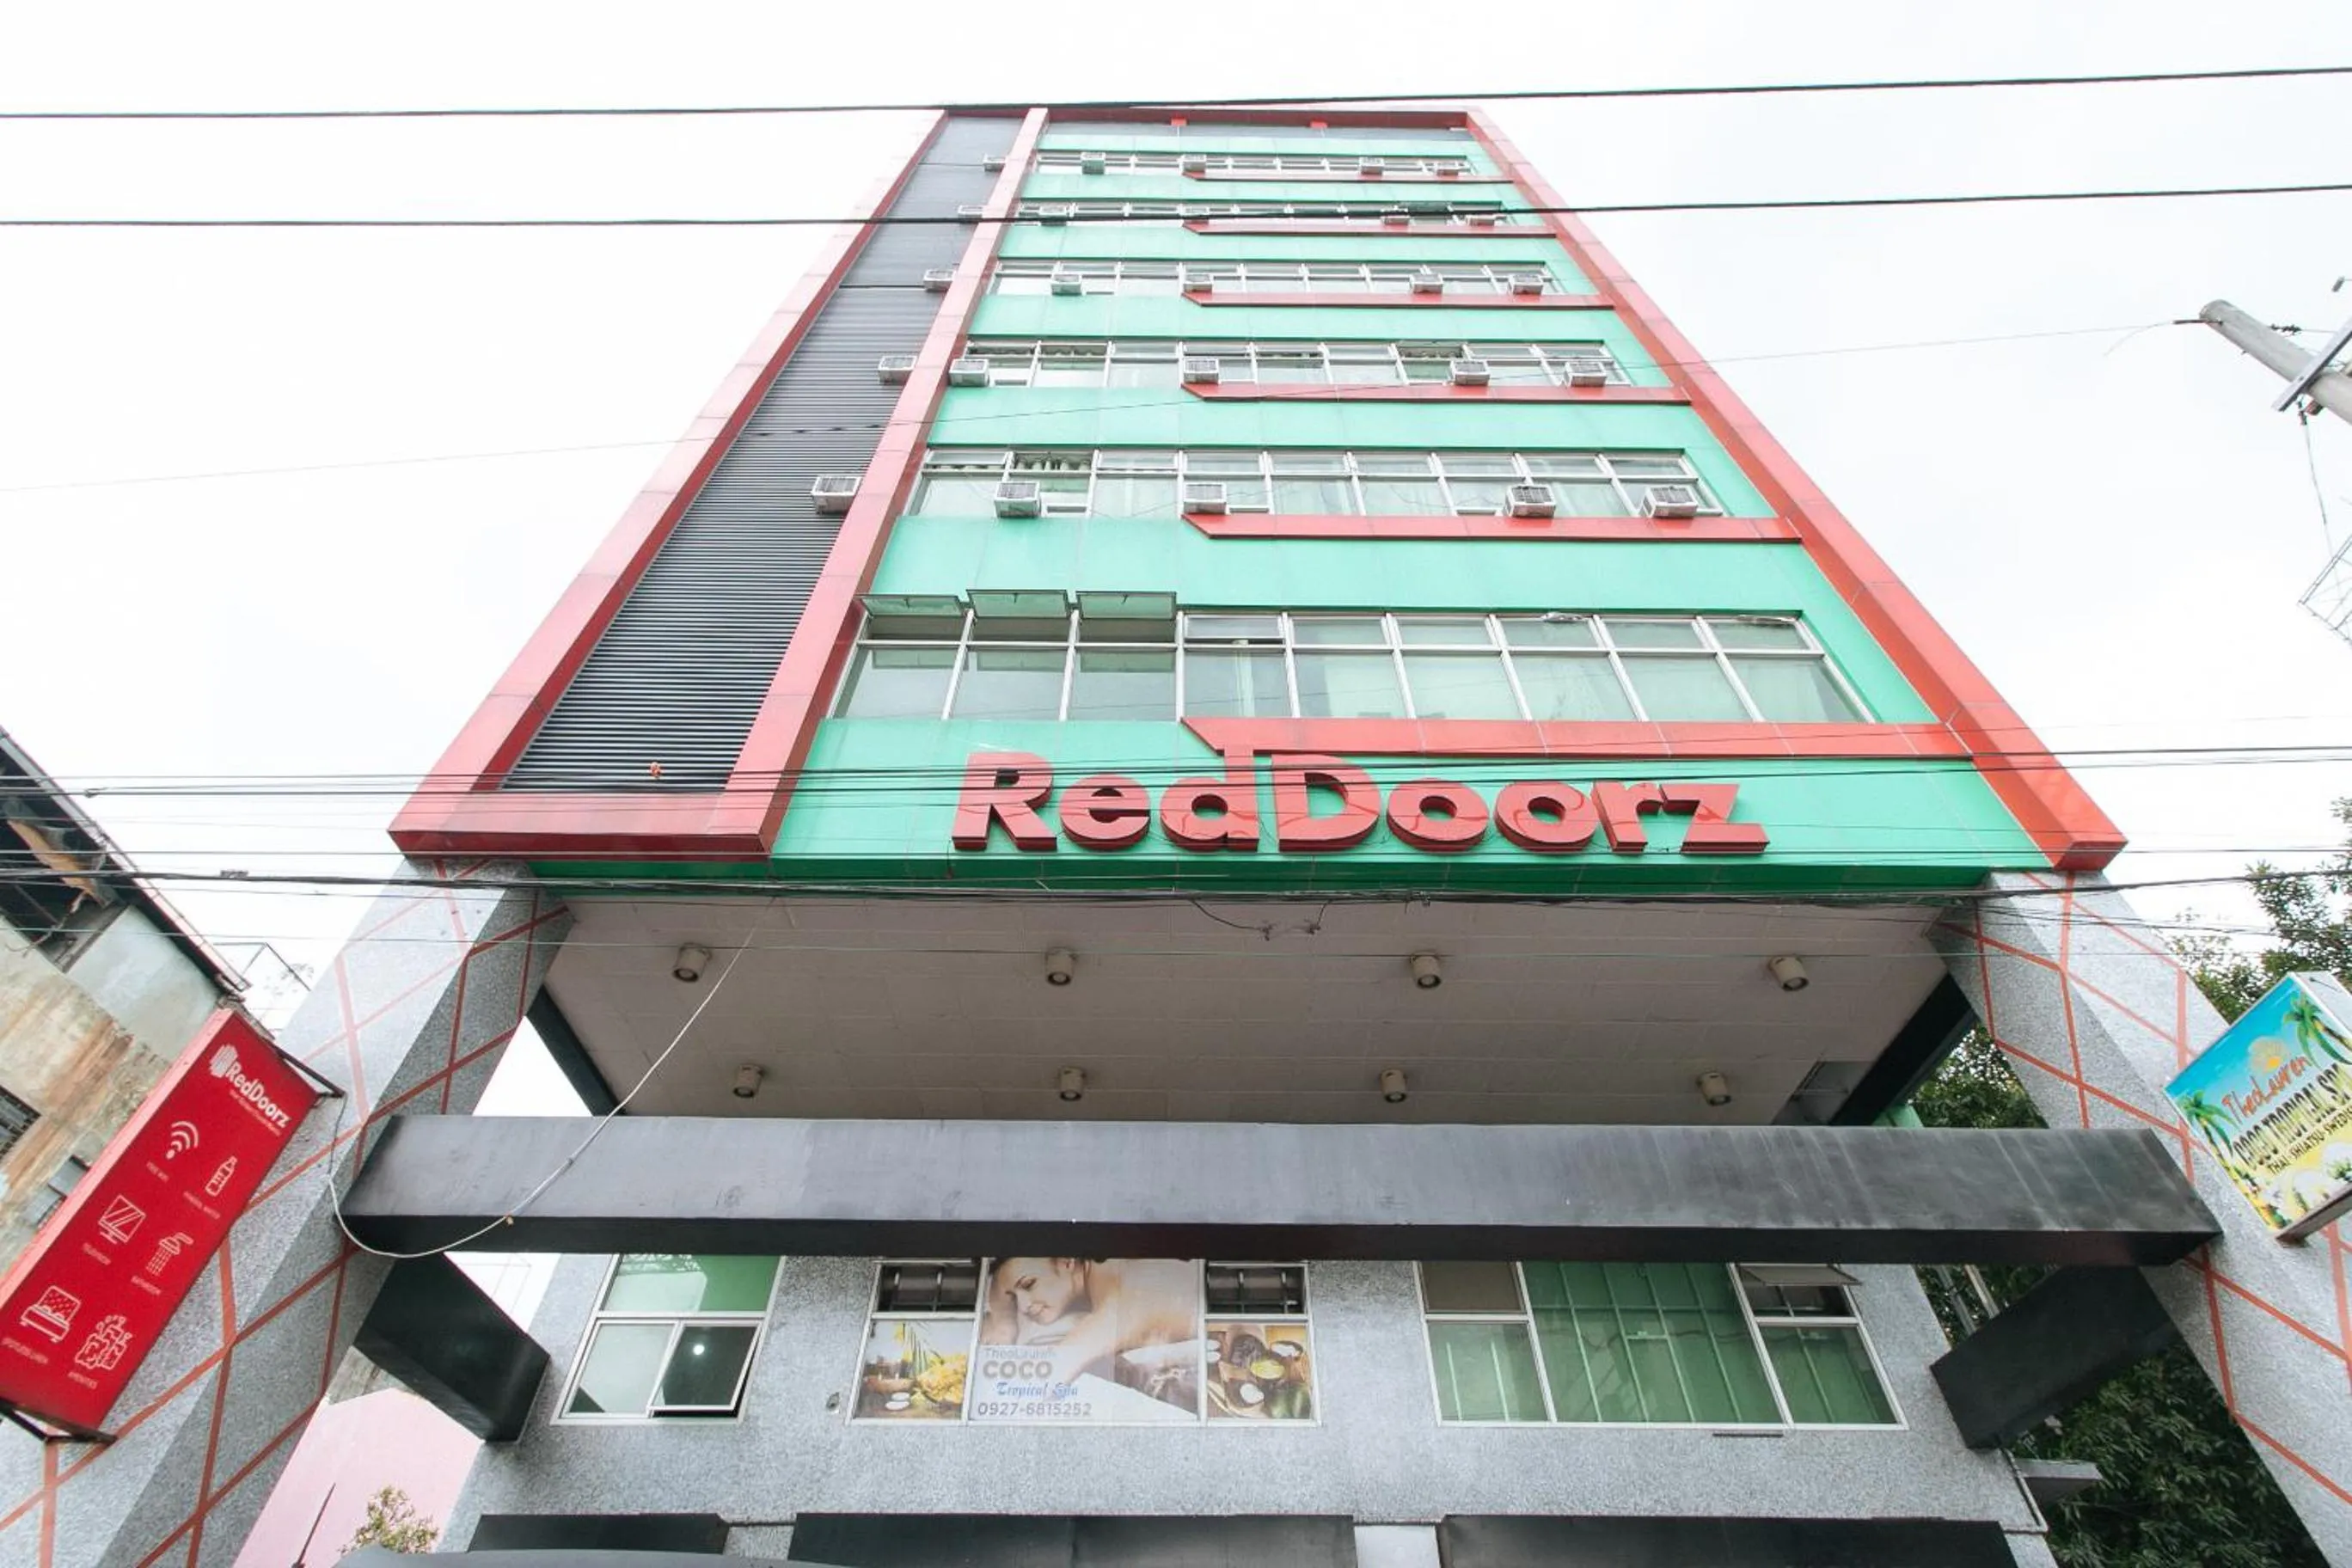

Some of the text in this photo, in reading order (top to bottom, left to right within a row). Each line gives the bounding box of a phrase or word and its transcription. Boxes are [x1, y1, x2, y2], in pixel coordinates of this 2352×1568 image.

[952, 747, 1769, 853] RedDoorz
[225, 1061, 291, 1128] RedDoorz
[2232, 1124, 2279, 1172] COCO
[2261, 1082, 2337, 1146] TROPICAL
[983, 1360, 1053, 1380] COCO
[995, 1381, 1079, 1400] Tropical Spa
